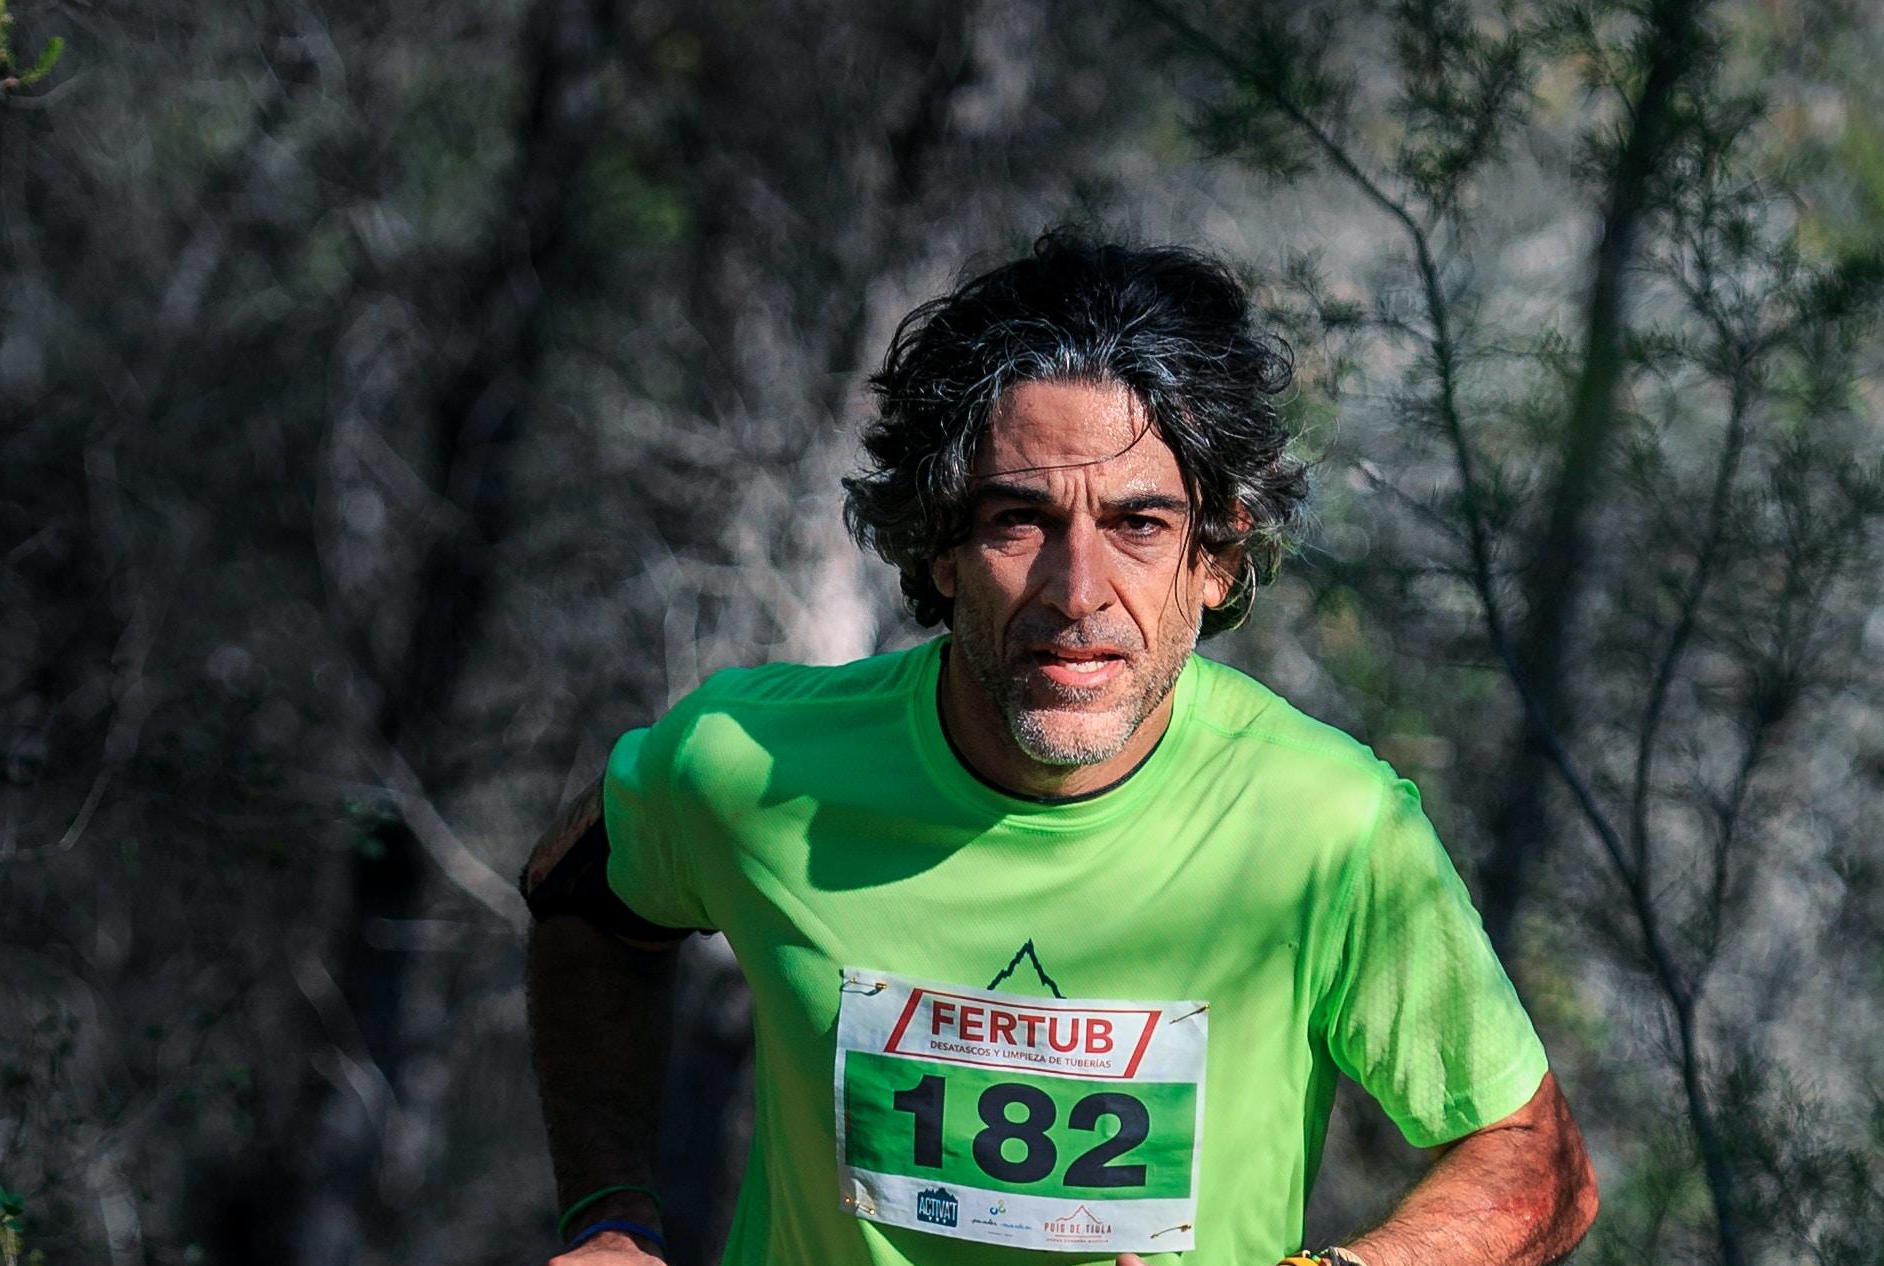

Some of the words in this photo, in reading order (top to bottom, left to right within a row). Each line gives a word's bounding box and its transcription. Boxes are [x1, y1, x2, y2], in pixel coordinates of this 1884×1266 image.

[931, 1001, 1114, 1054] FERTUB
[930, 1040, 991, 1057] DESATASCOS
[1002, 1050, 1046, 1063] LIMPIEZA
[1048, 1056, 1061, 1065] DE
[1065, 1058, 1112, 1069] TUBERÍAS
[893, 1074, 1150, 1188] 182
[1044, 1222, 1065, 1233] PUIG
[1070, 1223, 1081, 1234] DE
